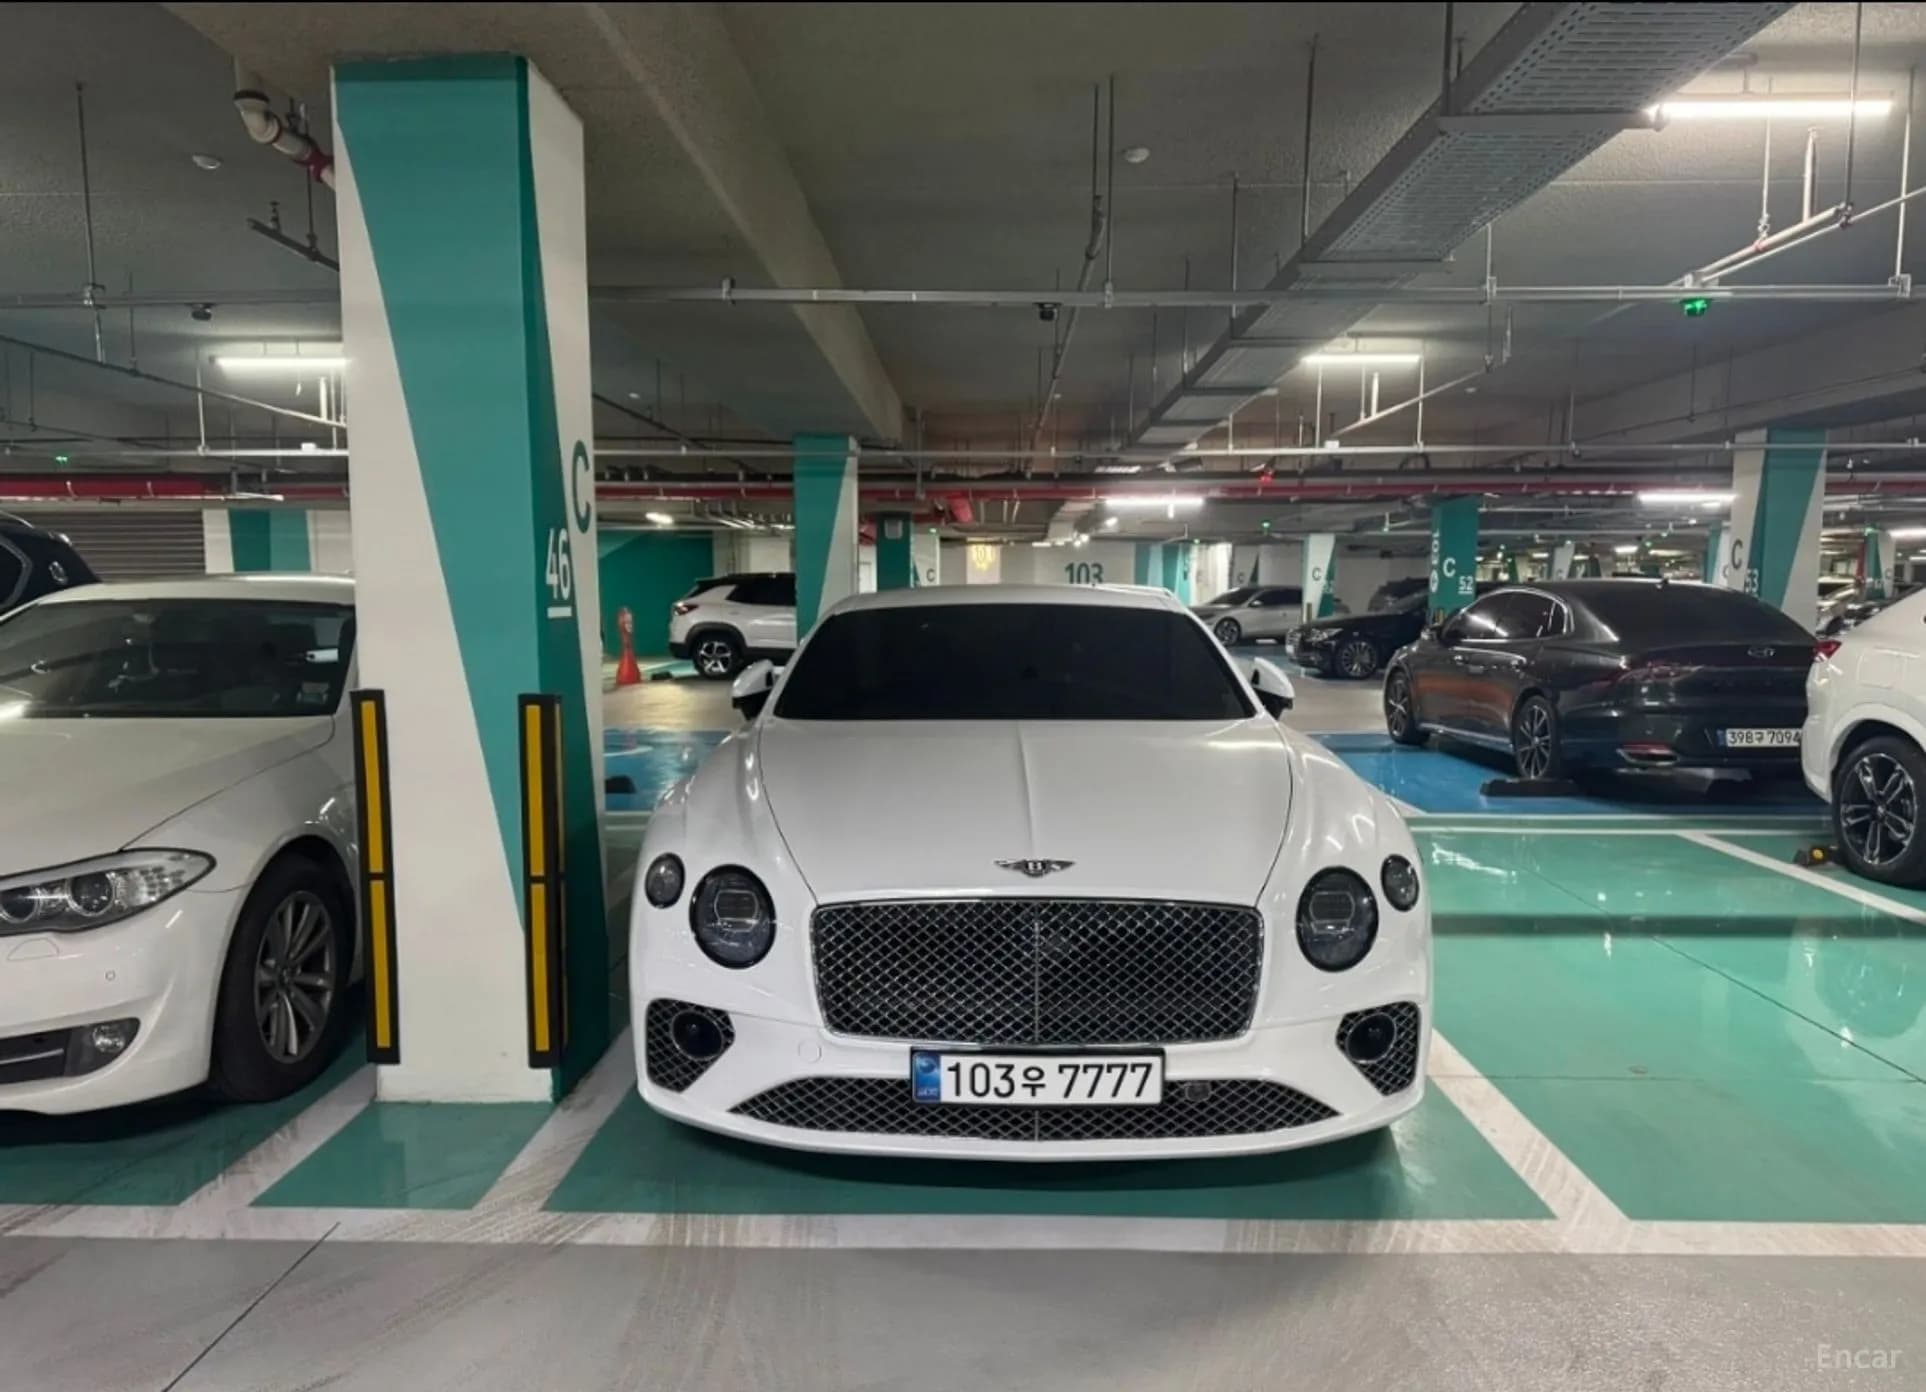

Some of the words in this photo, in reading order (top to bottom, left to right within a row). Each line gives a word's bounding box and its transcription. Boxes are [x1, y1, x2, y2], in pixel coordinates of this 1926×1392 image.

[572, 439, 591, 534] C
[546, 527, 571, 600] 46
[1731, 539, 1743, 570] C
[926, 568, 935, 583] C
[1064, 562, 1104, 584] 103
[1312, 567, 1322, 581] C
[1443, 557, 1456, 578] C
[1458, 576, 1473, 591] 52
[947, 1062, 1046, 1098] 103우
[1058, 1063, 1152, 1098] 7777
